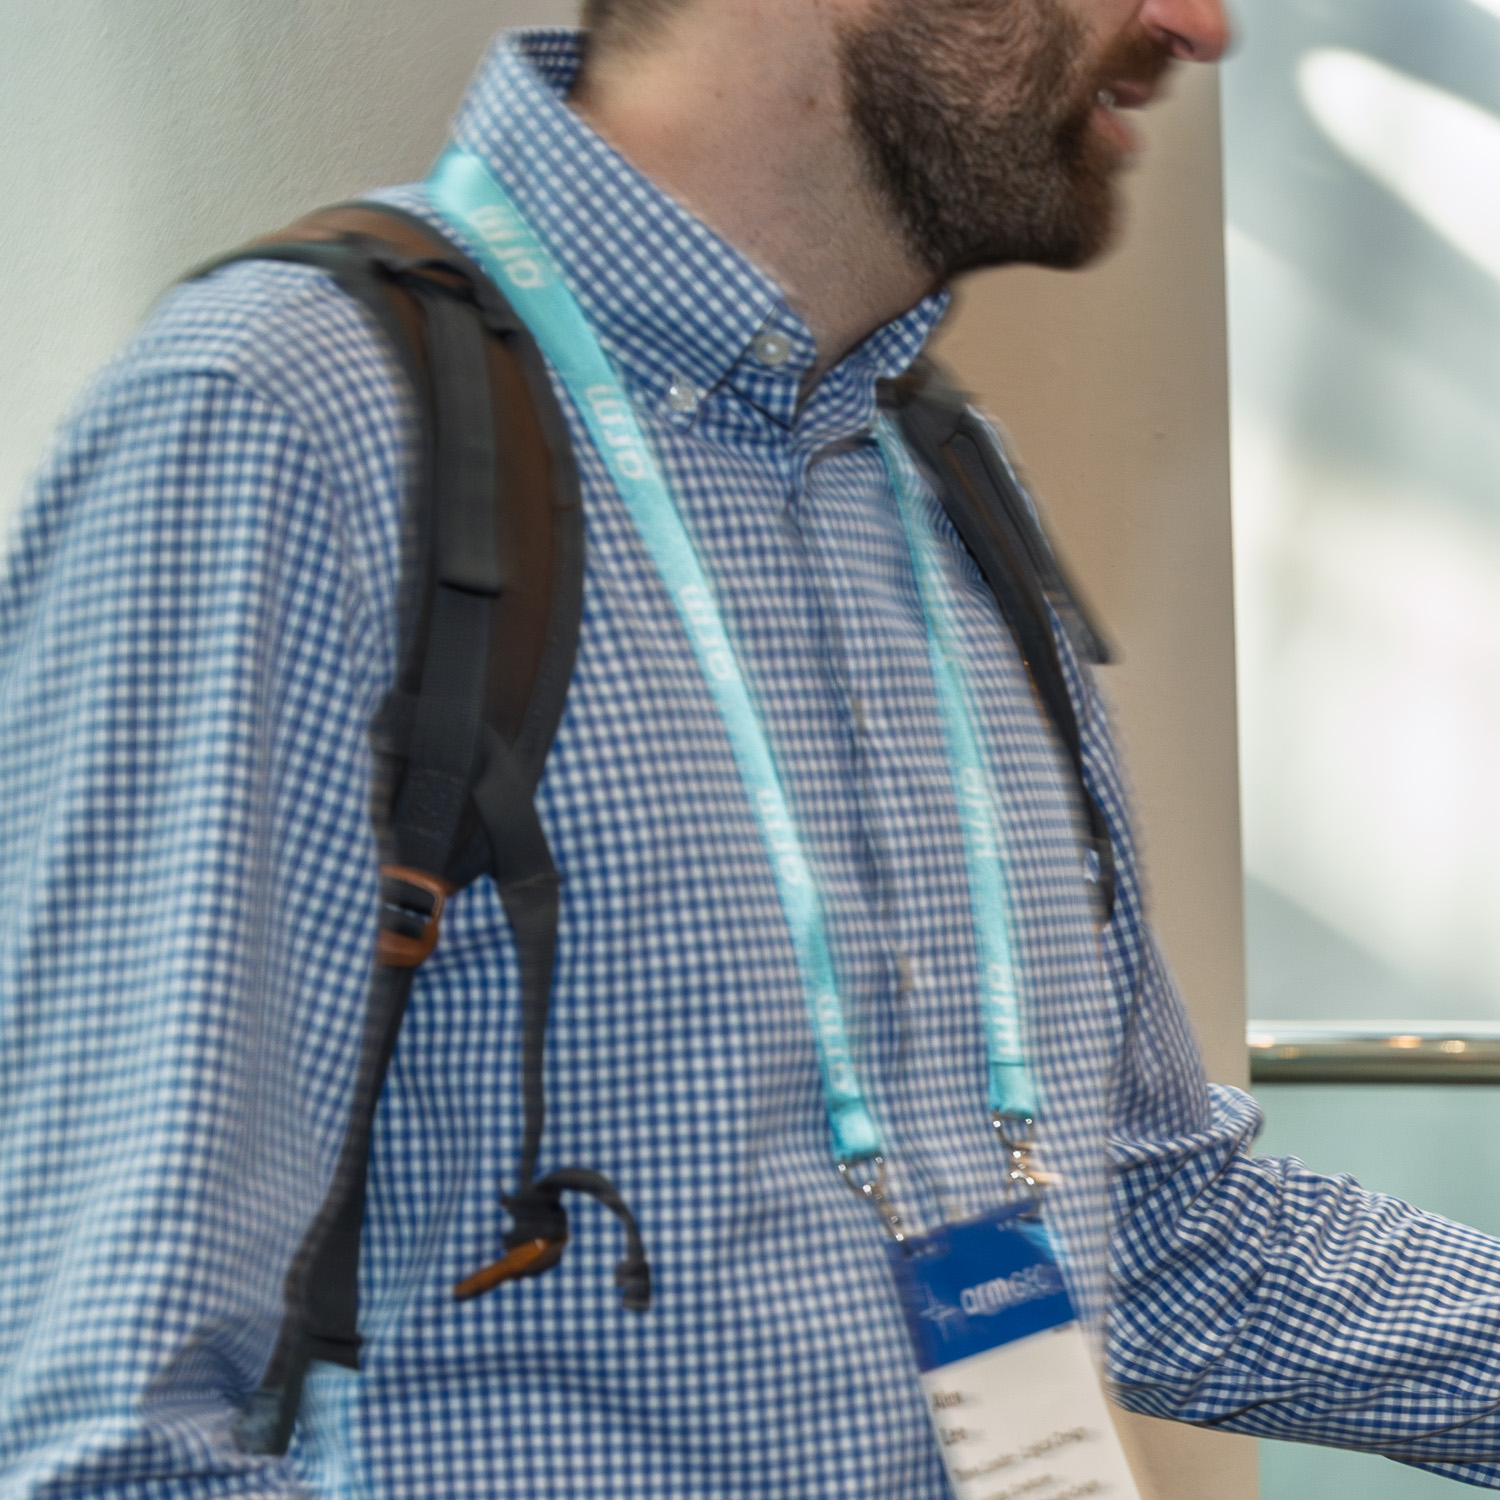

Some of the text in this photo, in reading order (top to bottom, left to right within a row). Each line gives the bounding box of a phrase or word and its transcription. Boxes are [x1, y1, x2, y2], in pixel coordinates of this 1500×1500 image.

[585, 384, 647, 480] arm
[678, 583, 737, 682] arm
[756, 788, 801, 887] arm
